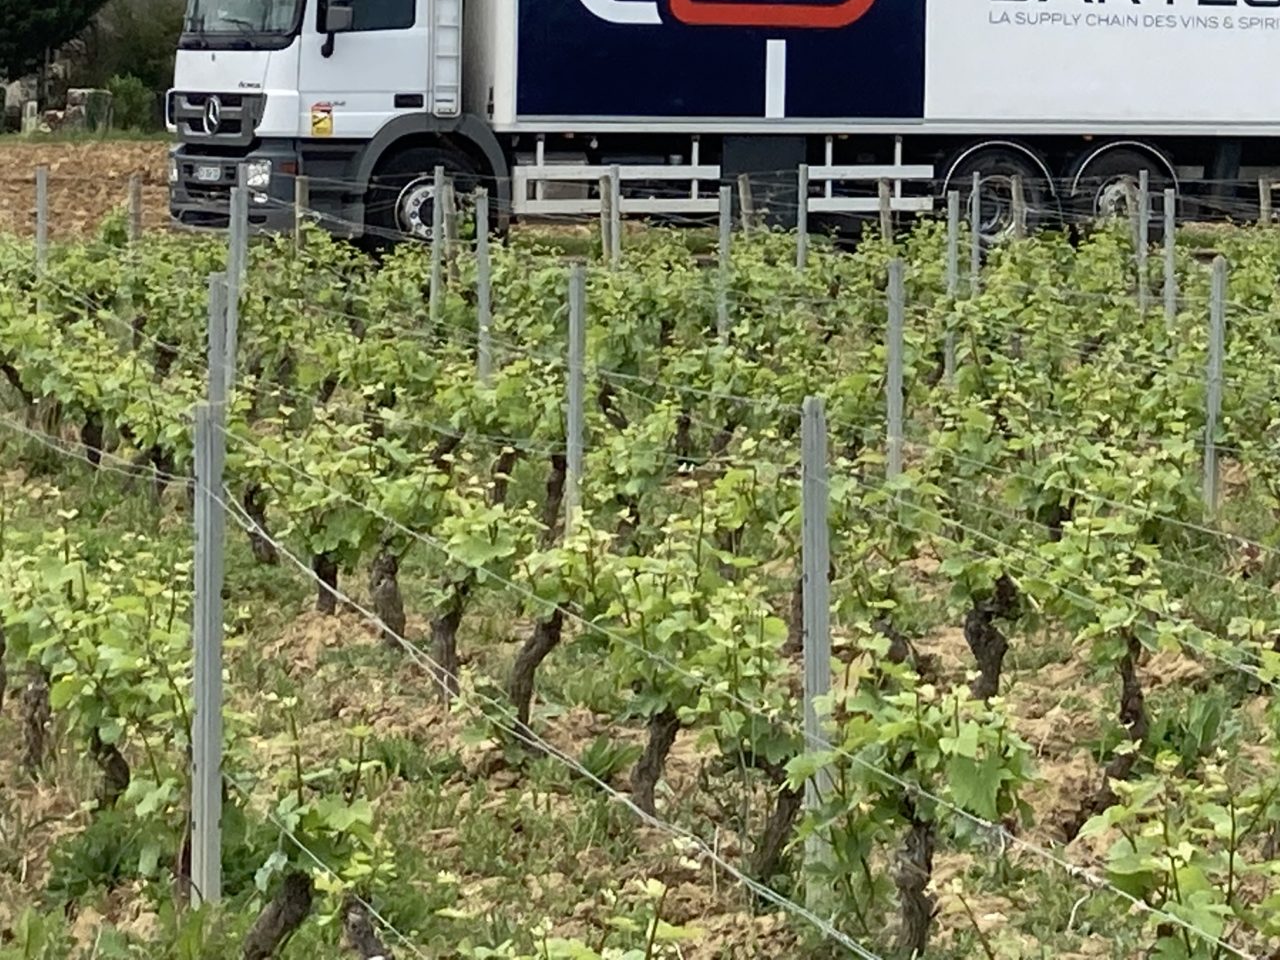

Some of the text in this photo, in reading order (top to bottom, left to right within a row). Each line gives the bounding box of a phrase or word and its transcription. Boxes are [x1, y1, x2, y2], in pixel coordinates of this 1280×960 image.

[989, 11, 1011, 24] LA
[1015, 11, 1082, 26] SUPPLY
[1085, 13, 1138, 27] CHAIN
[1143, 14, 1177, 28] DES
[1180, 15, 1219, 29] VINS
[1222, 16, 1234, 29] &
